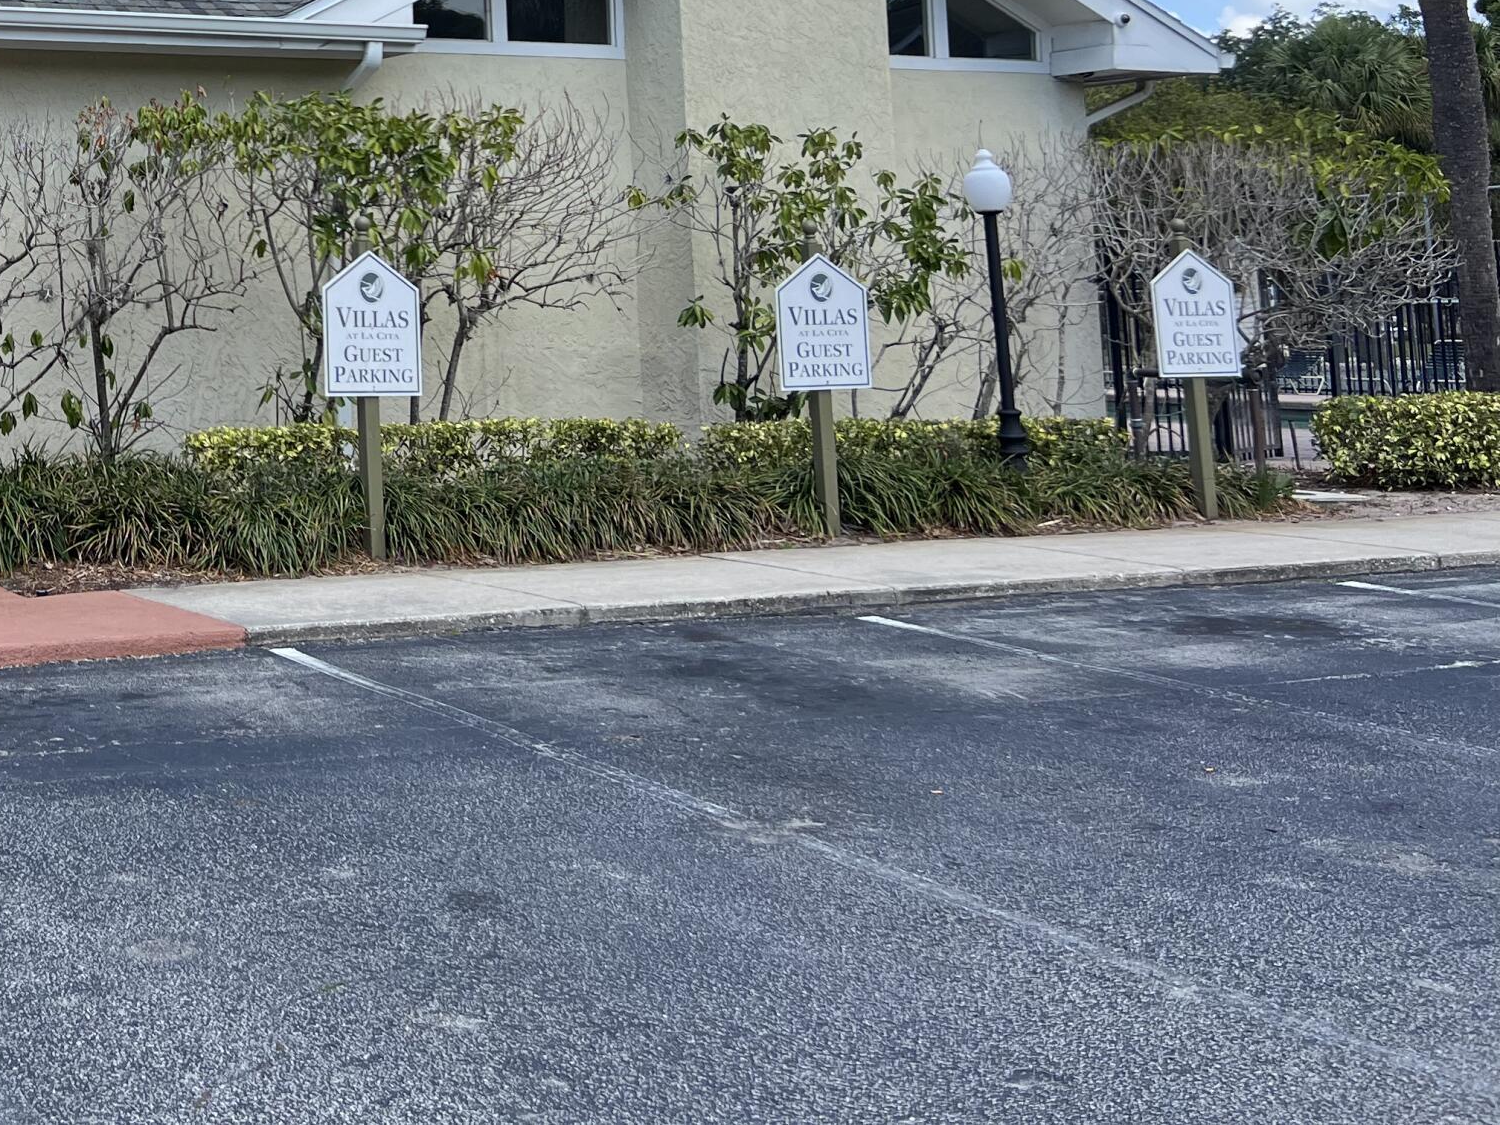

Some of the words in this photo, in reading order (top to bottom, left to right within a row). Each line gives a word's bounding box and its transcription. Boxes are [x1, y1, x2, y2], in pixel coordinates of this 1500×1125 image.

[787, 306, 858, 326] VILLAS
[1163, 298, 1226, 317] VILLAS
[335, 306, 410, 329] VILLAS
[1172, 331, 1223, 347] GUEST
[343, 345, 404, 363] GUEST
[796, 341, 853, 358] GUEST
[1166, 350, 1233, 365] PARKING
[334, 366, 413, 384] PARKING
[788, 361, 863, 378] PARKING
